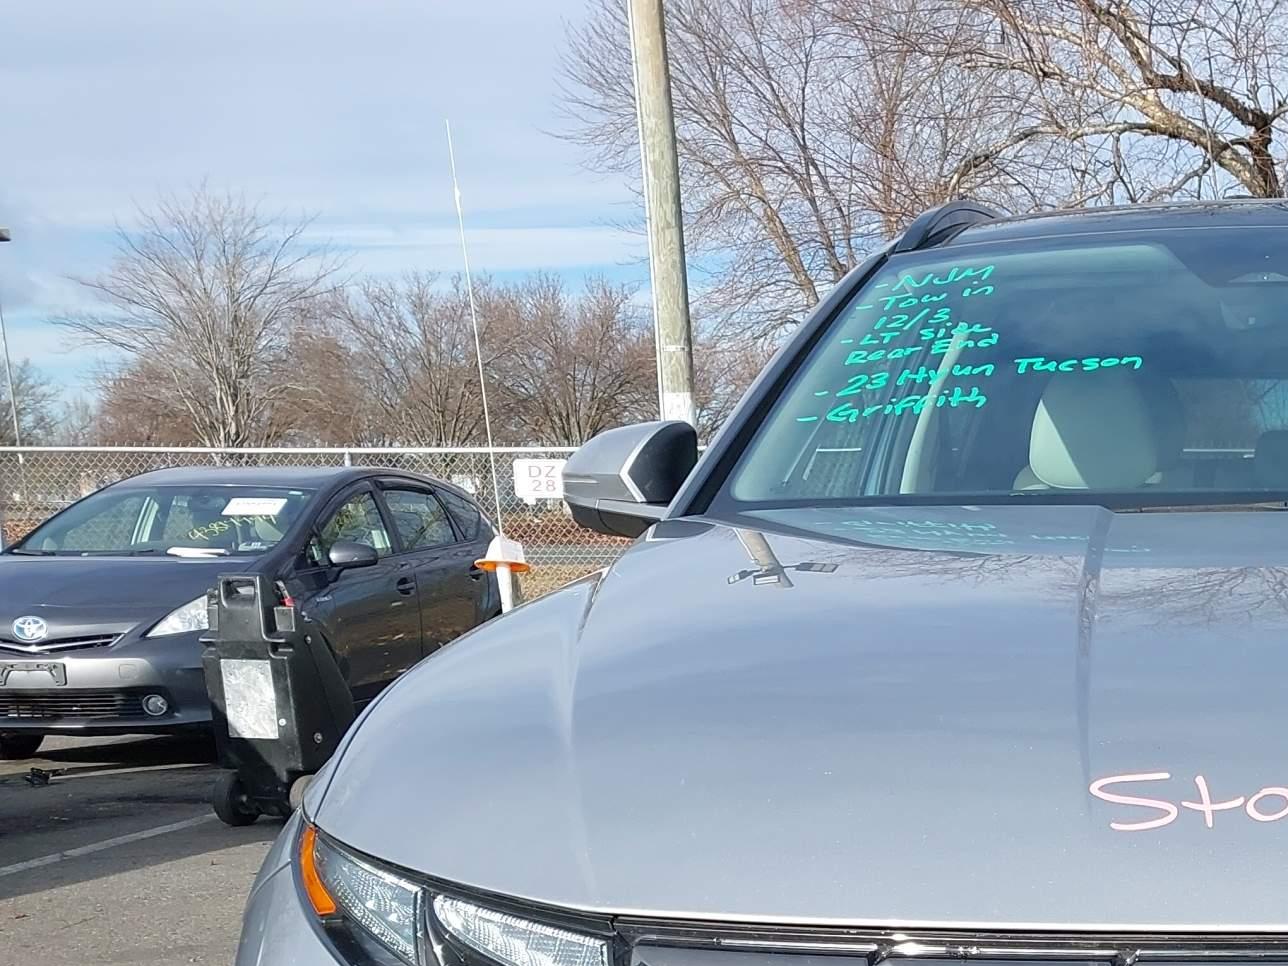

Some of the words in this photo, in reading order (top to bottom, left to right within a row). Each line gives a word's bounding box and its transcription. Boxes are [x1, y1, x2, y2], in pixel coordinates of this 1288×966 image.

[962, 281, 994, 297] in
[836, 371, 890, 397] 23
[528, 465, 557, 478] DZ
[532, 479, 557, 492] 28
